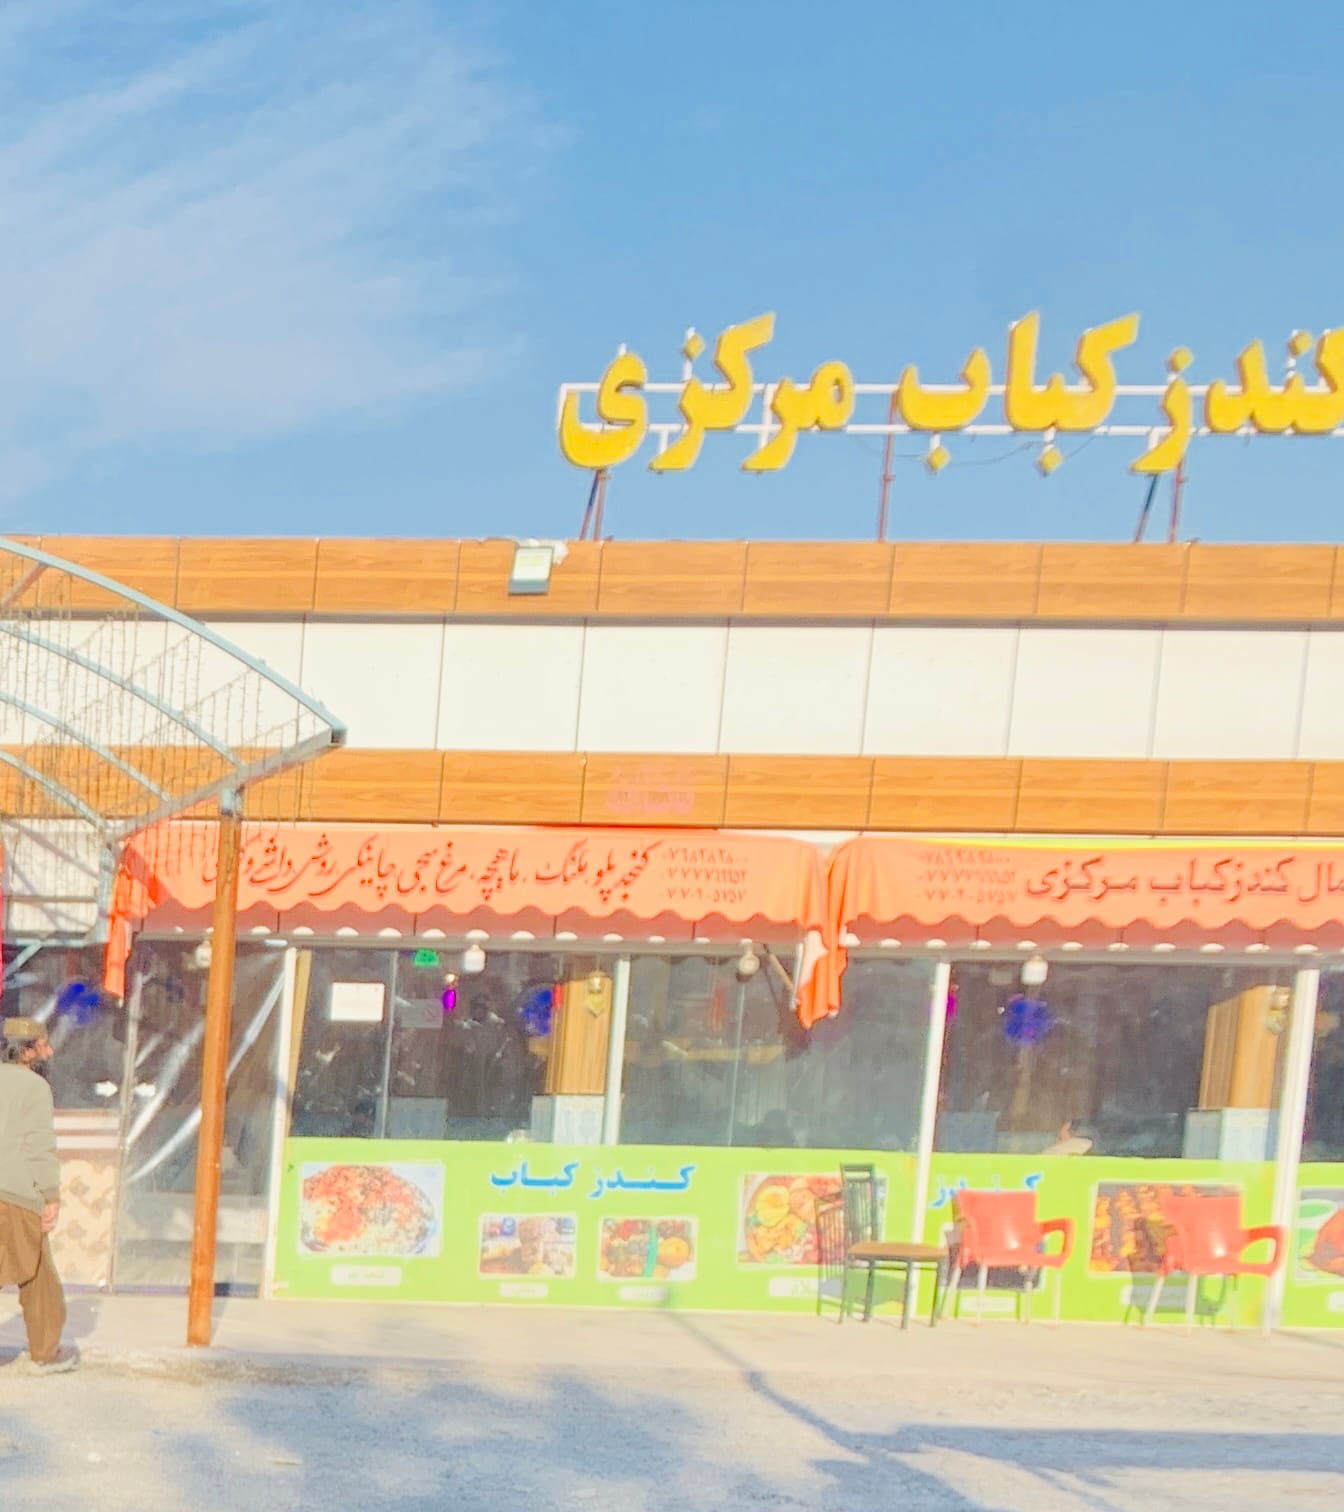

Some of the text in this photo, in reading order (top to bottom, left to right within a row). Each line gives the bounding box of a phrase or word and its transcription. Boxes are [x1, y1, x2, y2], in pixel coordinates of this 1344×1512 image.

[559, 310, 855, 473] مرکزی
[900, 309, 1142, 475] کباب
[1027, 856, 1138, 901] مرکزی
[1150, 857, 1233, 906] کباب
[490, 1160, 697, 1199] کندز کباب
